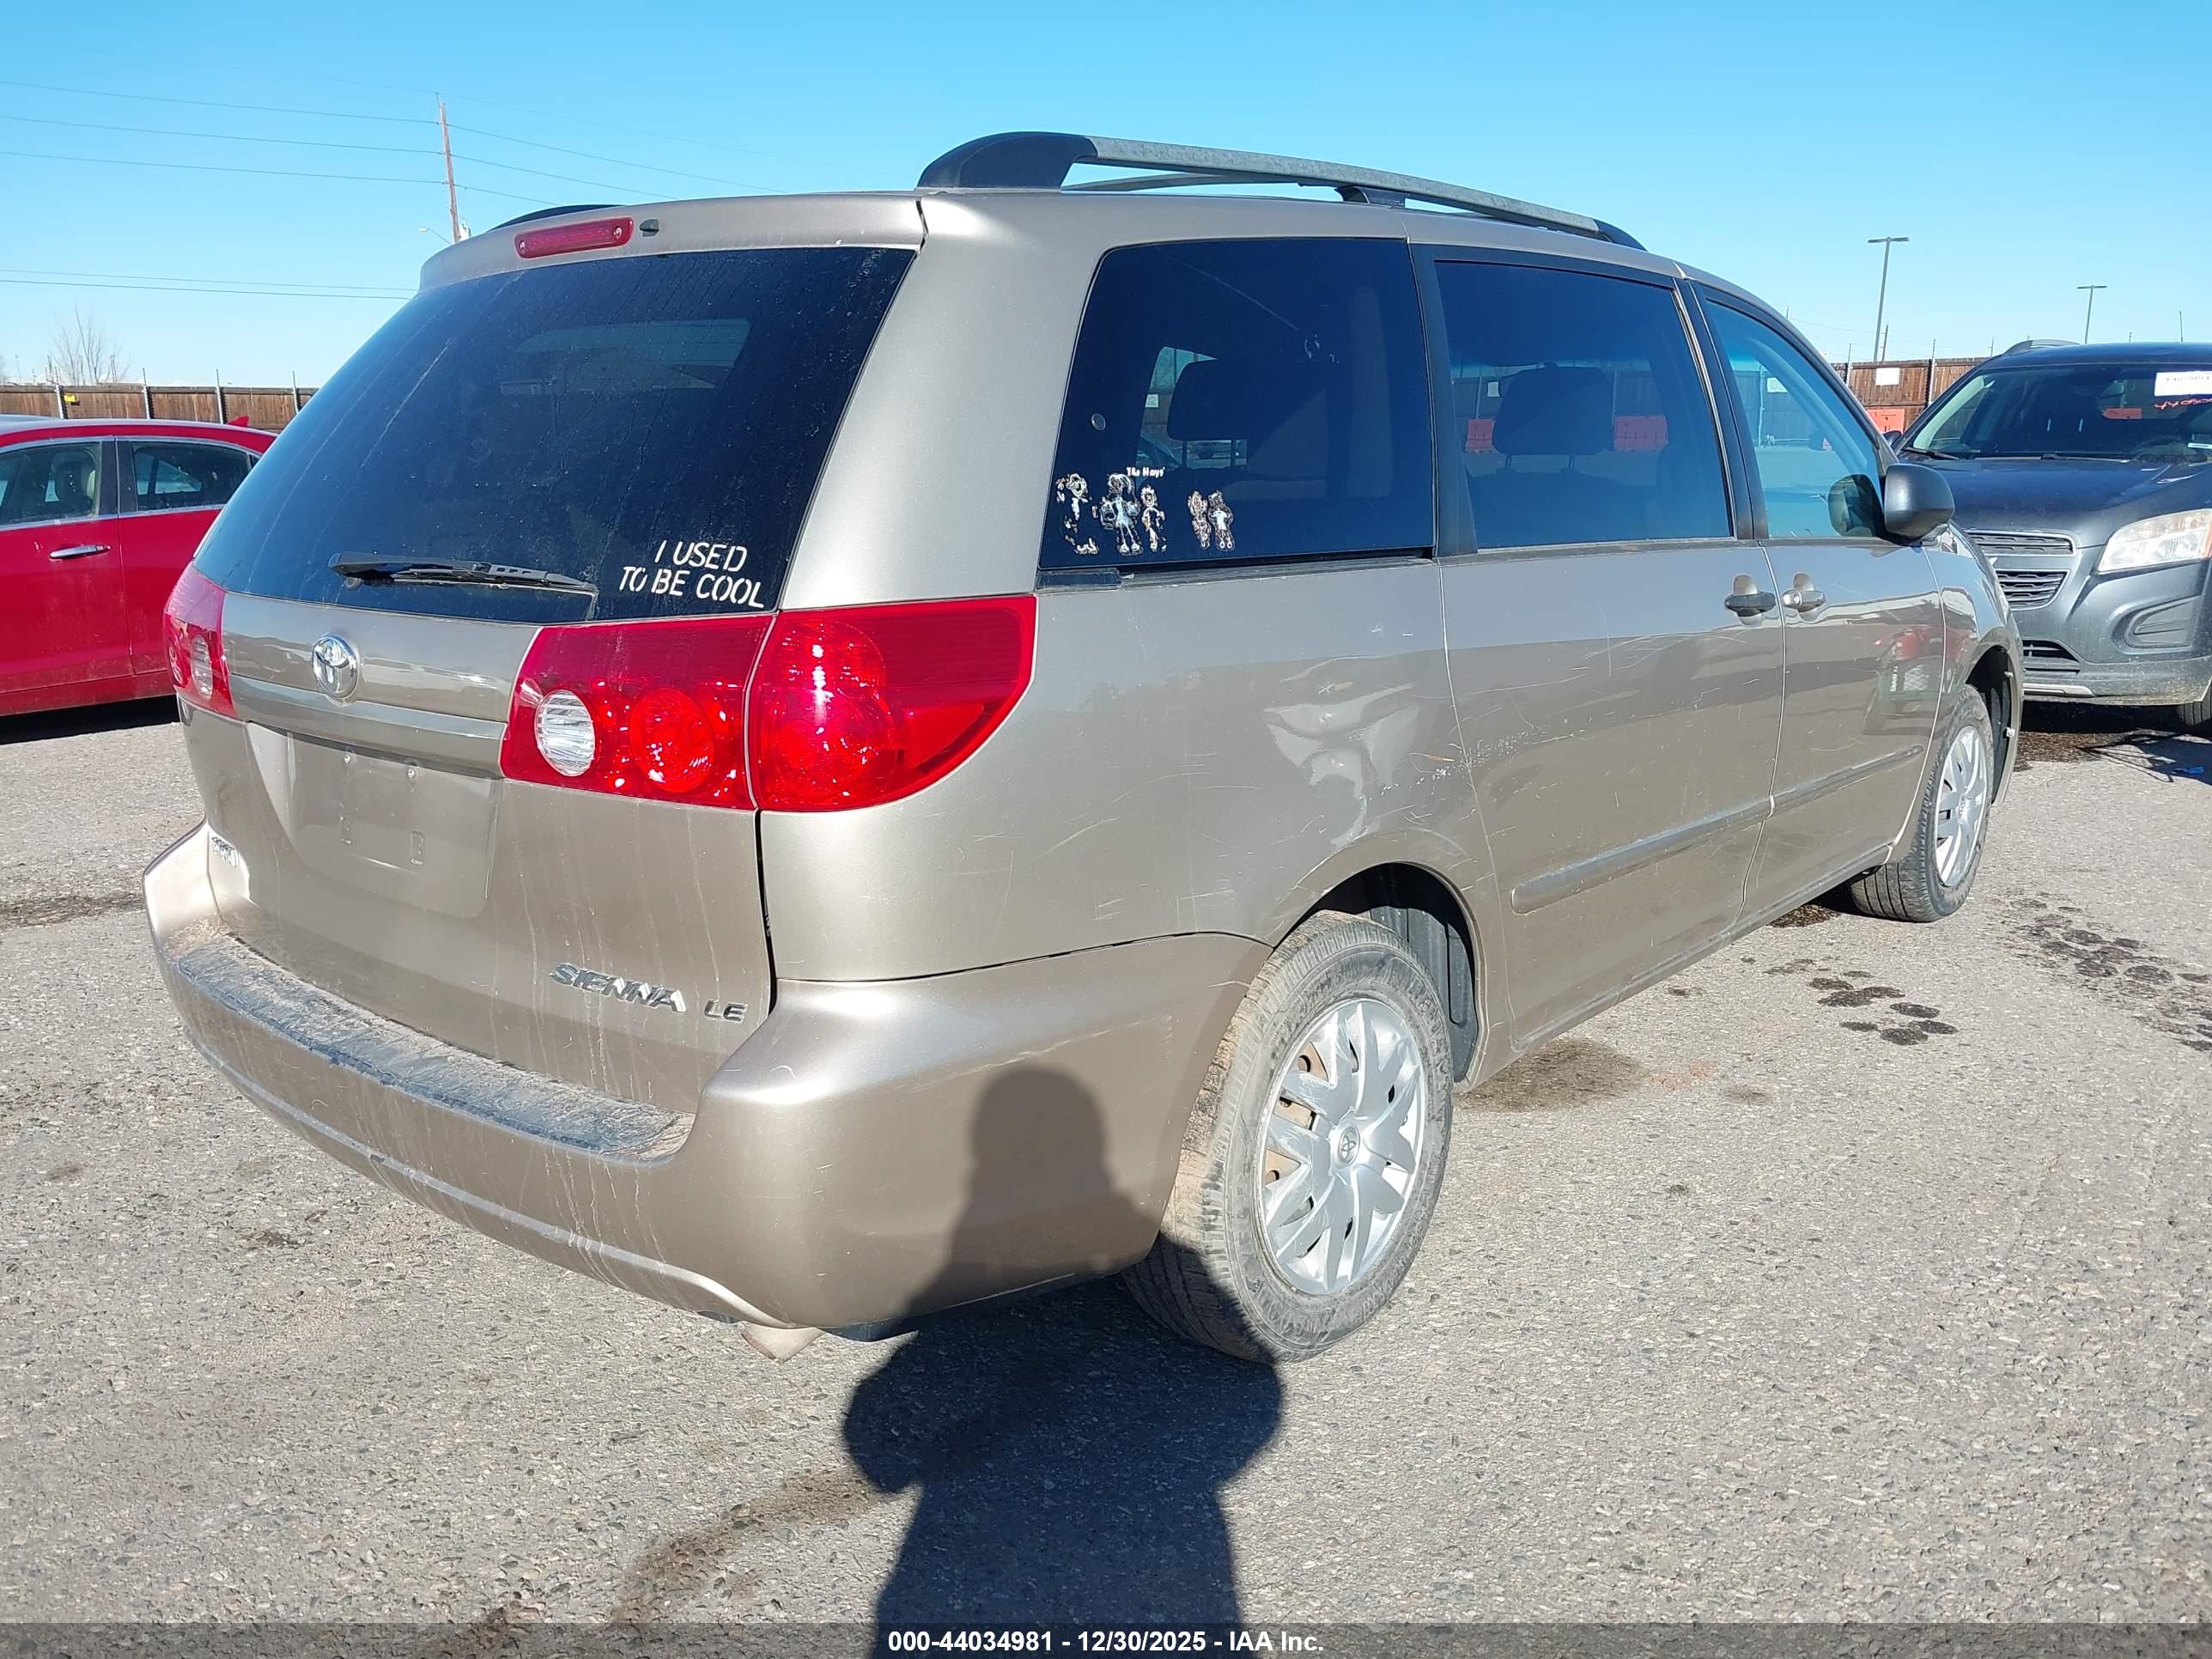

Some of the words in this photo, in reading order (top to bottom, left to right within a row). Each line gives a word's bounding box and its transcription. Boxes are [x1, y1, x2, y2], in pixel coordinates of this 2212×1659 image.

[654, 539, 667, 563] I
[673, 541, 748, 572] USED
[618, 566, 648, 592] TO
[651, 568, 690, 596] BE
[696, 574, 764, 609] COOL
[549, 962, 687, 1014] SIENNA
[703, 999, 749, 1023] LE
